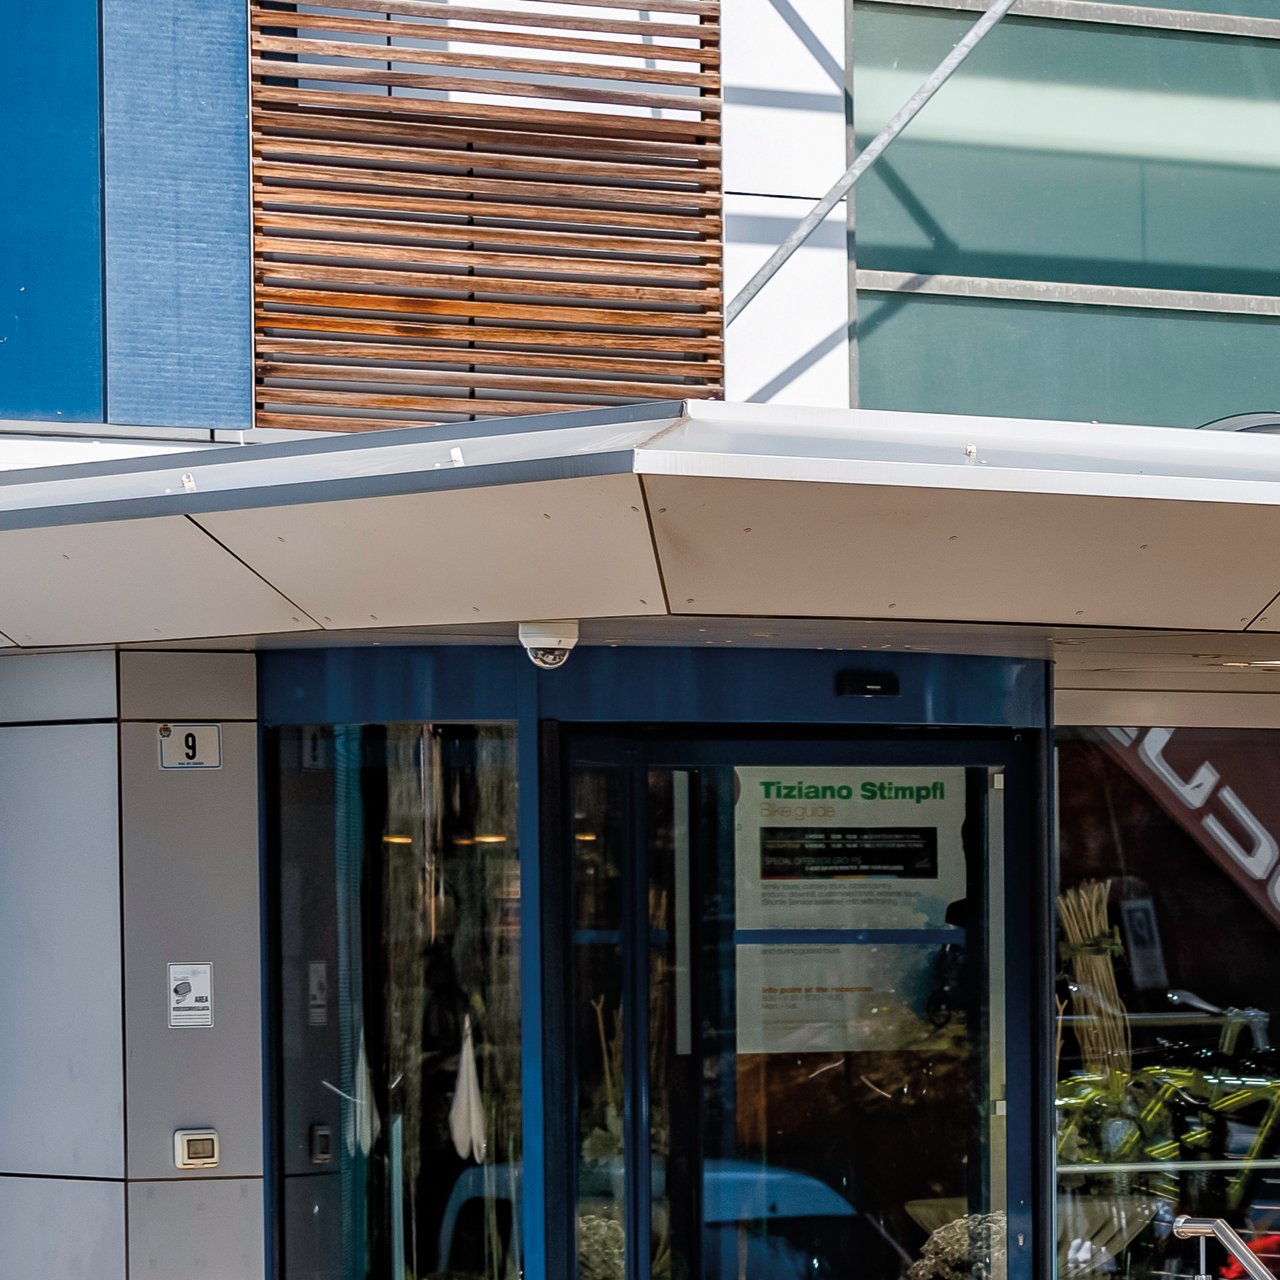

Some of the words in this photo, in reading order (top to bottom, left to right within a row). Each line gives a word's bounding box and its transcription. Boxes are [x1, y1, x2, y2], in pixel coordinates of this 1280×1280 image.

[185, 732, 196, 760] 9
[760, 781, 853, 800] Tiziano
[861, 781, 945, 803] Stimpfl
[760, 803, 792, 818] Bike
[795, 803, 836, 821] guide
